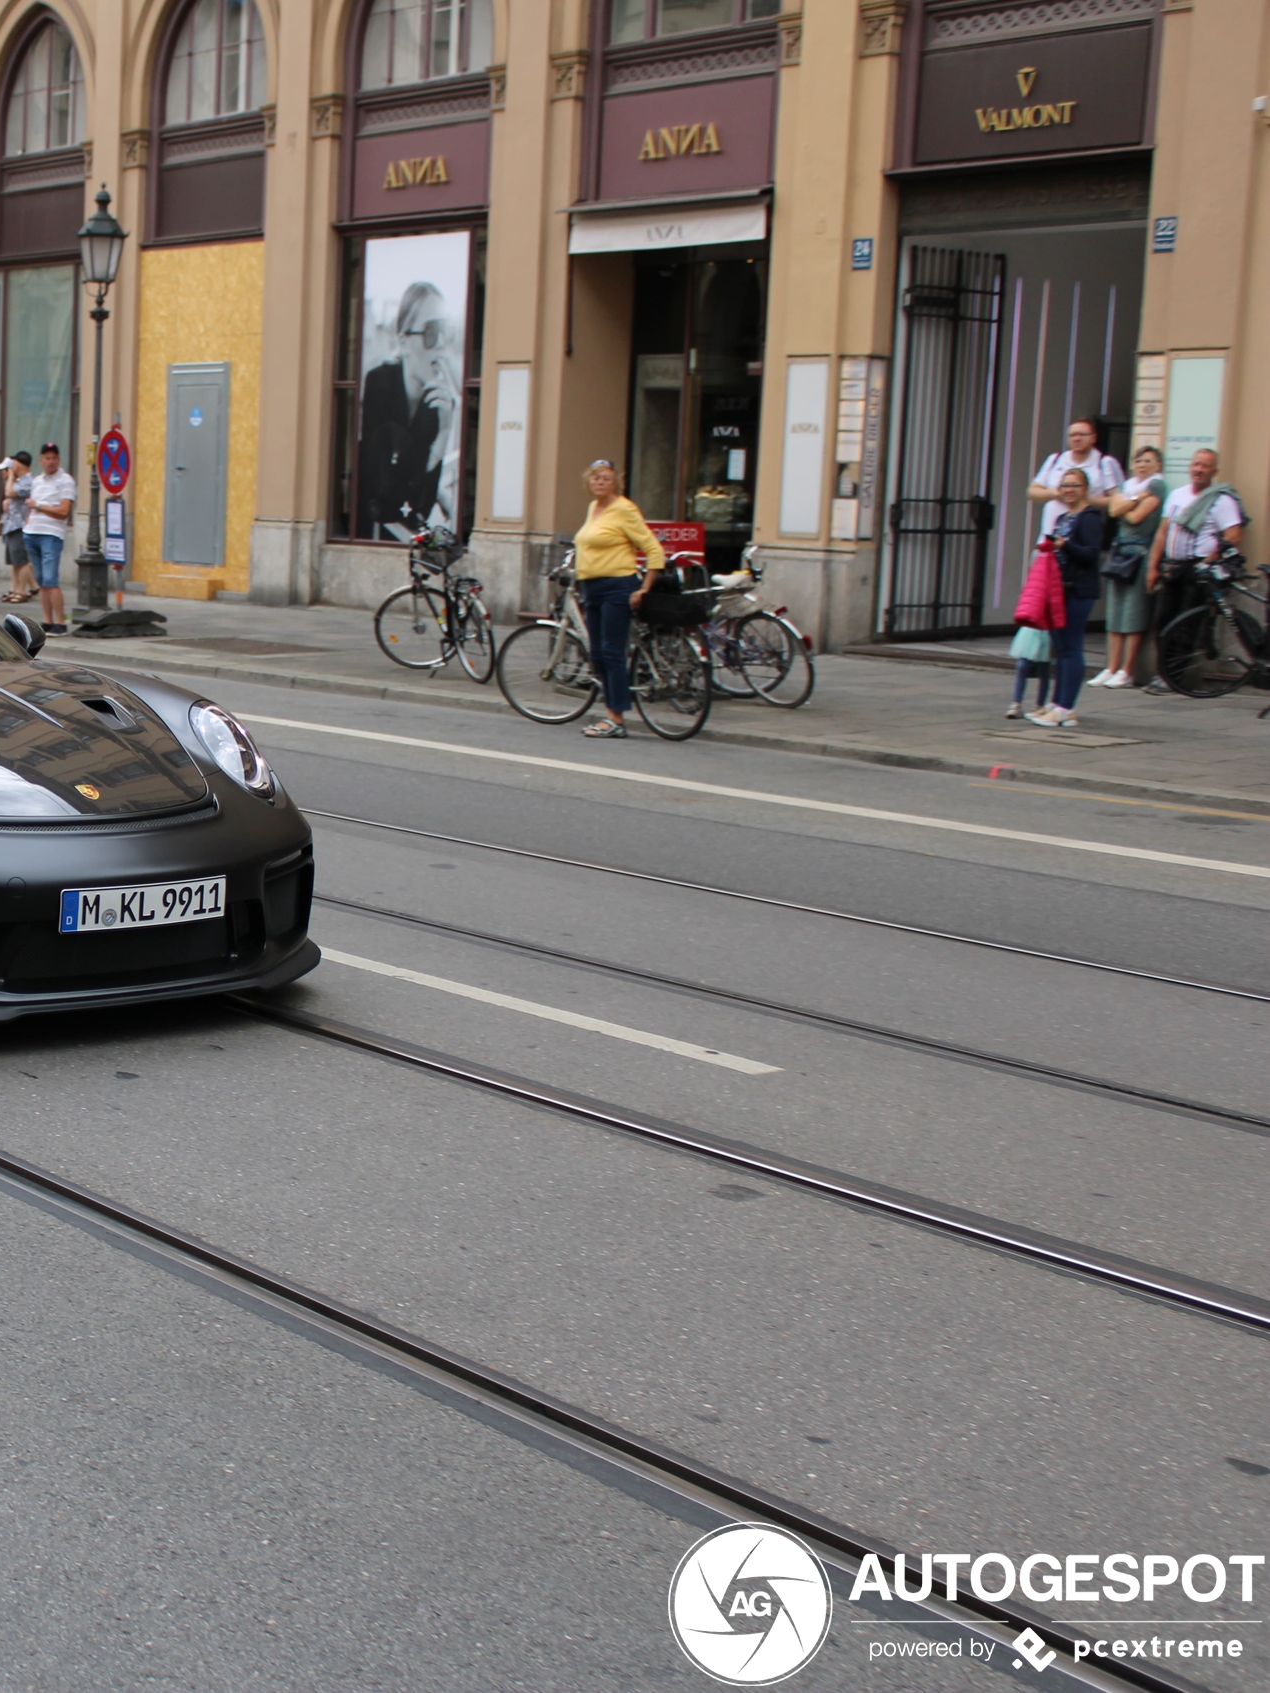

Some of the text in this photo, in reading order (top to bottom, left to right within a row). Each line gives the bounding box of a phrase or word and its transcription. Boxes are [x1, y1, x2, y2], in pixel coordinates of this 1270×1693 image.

[975, 101, 1077, 132] VALMONT
[1155, 219, 1175, 236] 22
[853, 240, 870, 256] 24
[82, 883, 221, 925] M KL 9911
[66, 916, 73, 925] D
